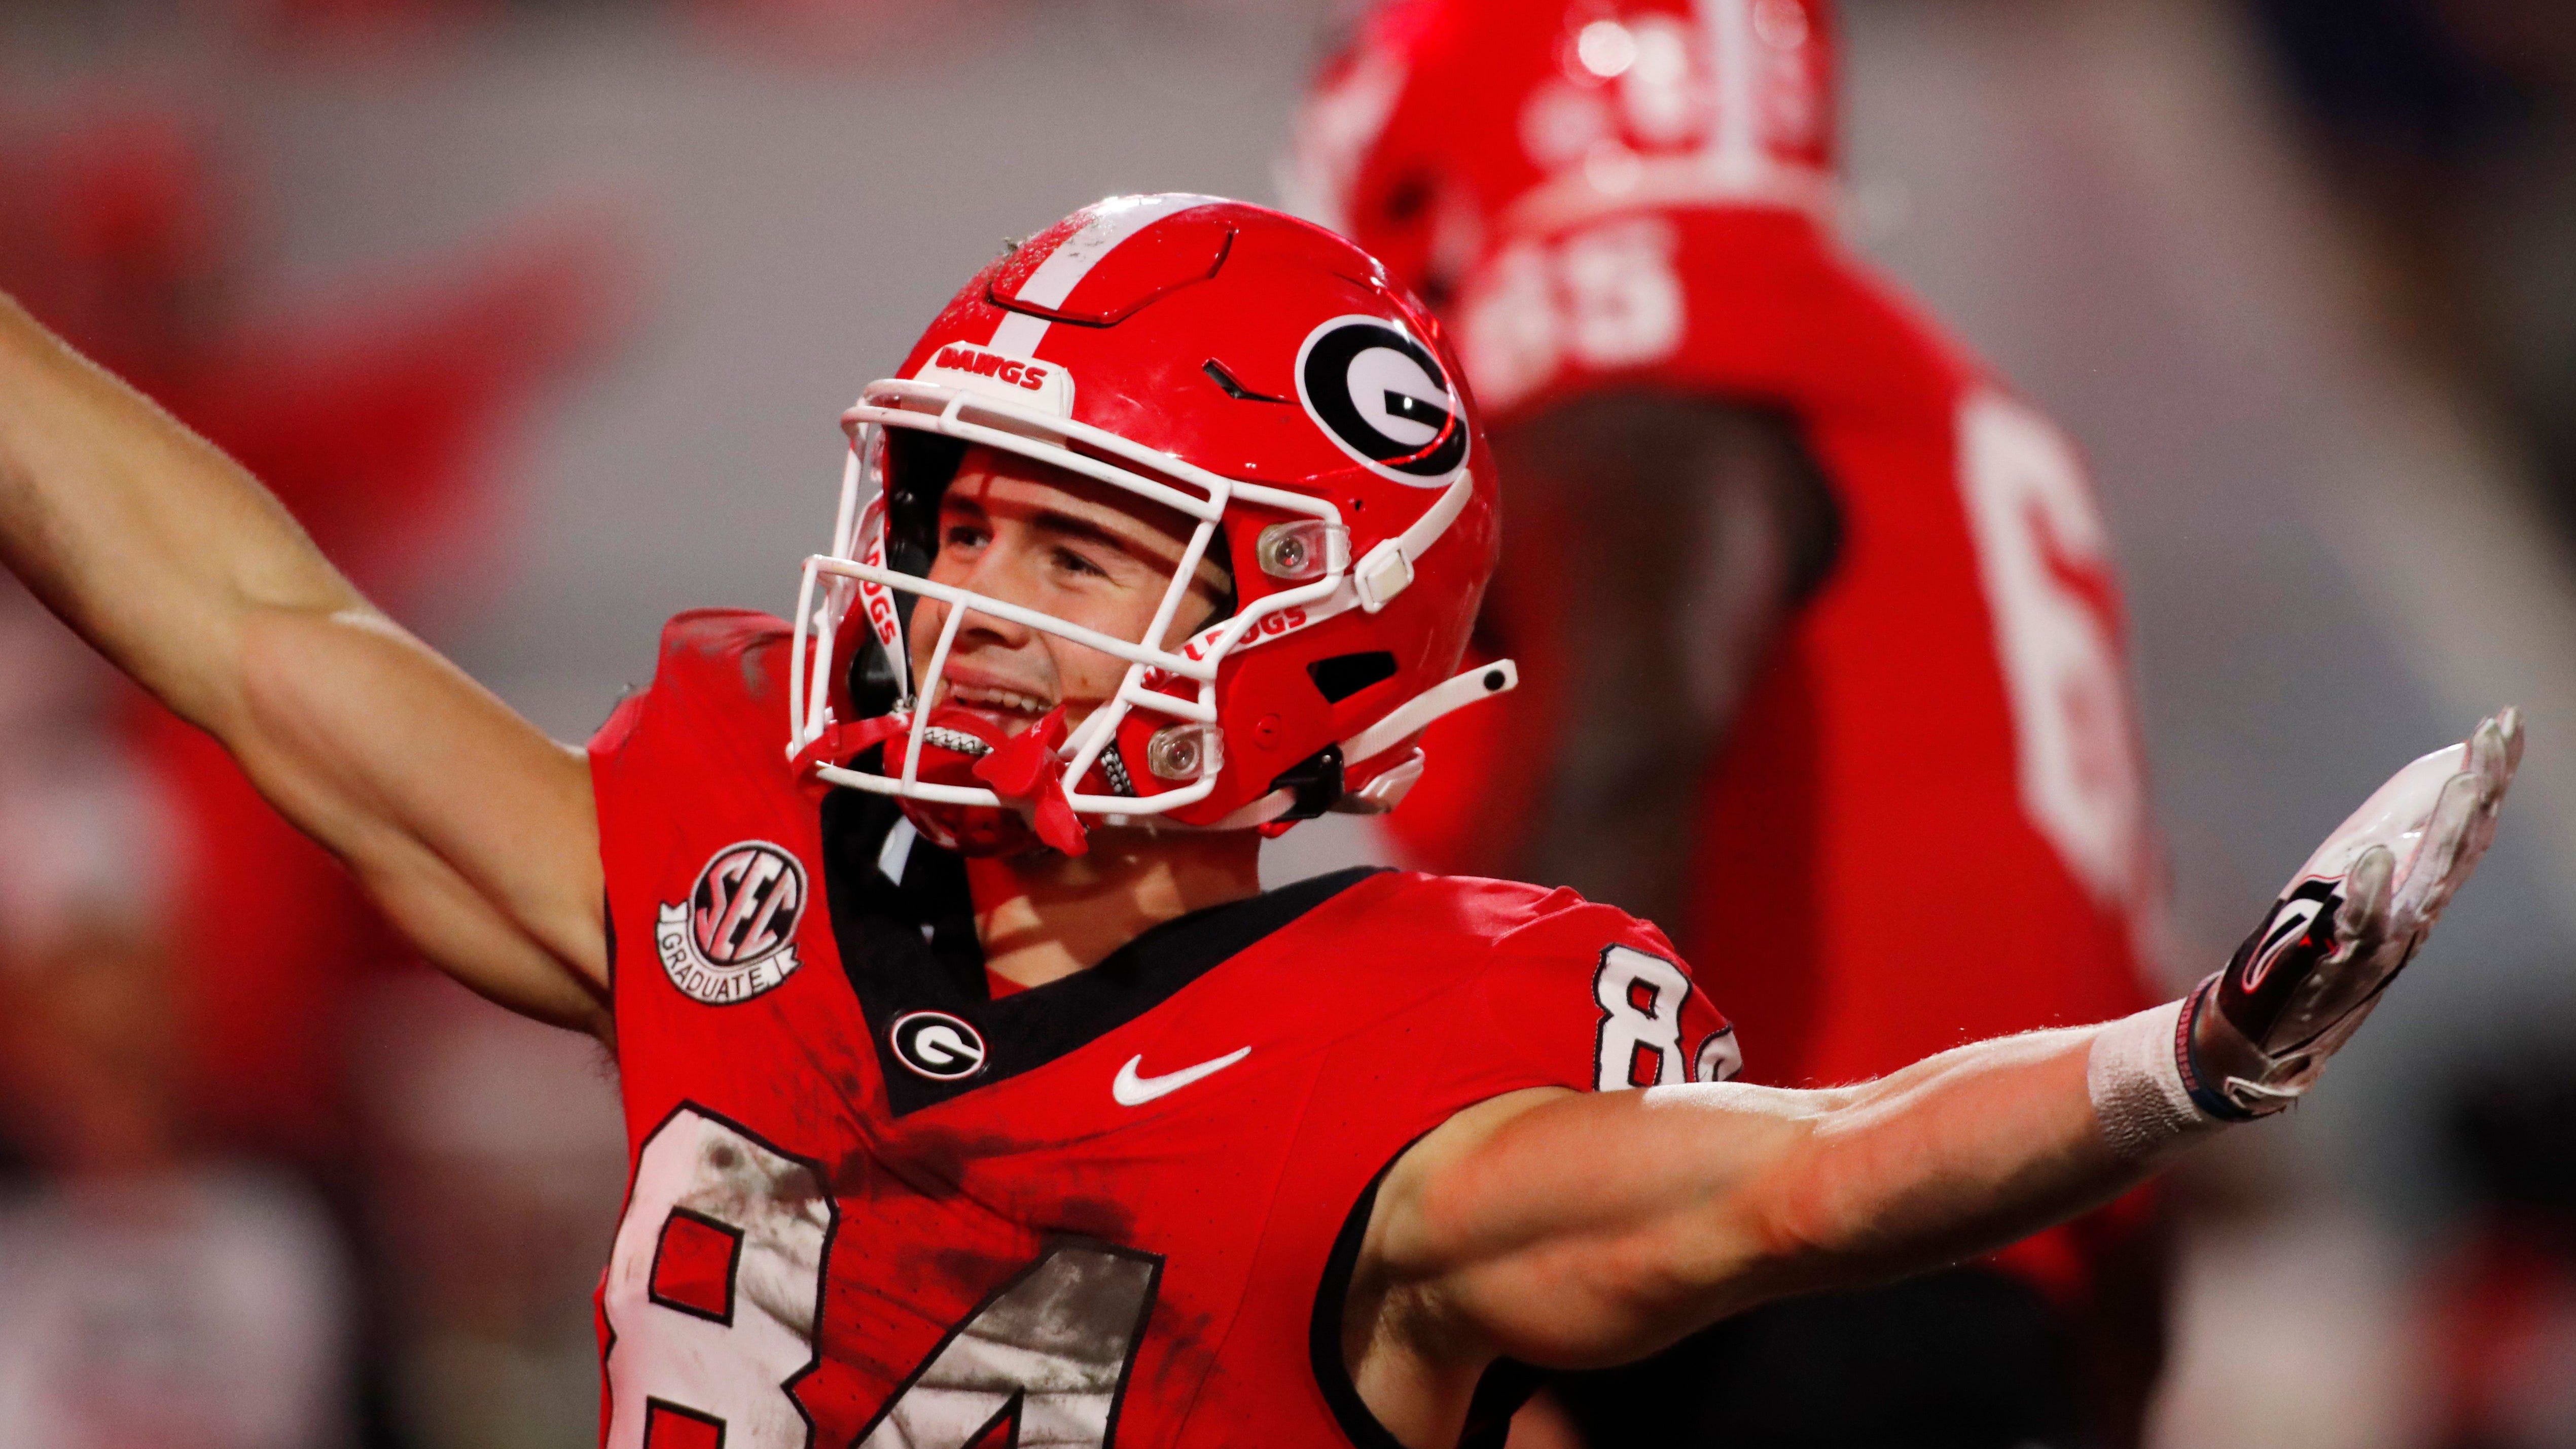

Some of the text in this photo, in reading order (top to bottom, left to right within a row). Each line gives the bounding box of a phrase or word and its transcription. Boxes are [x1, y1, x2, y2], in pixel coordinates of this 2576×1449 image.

[936, 347, 1048, 391] DAWGS
[1301, 321, 1469, 480] G
[695, 849, 798, 962] SEC
[662, 932, 763, 999] GRADUATE
[893, 1012, 984, 1078] G
